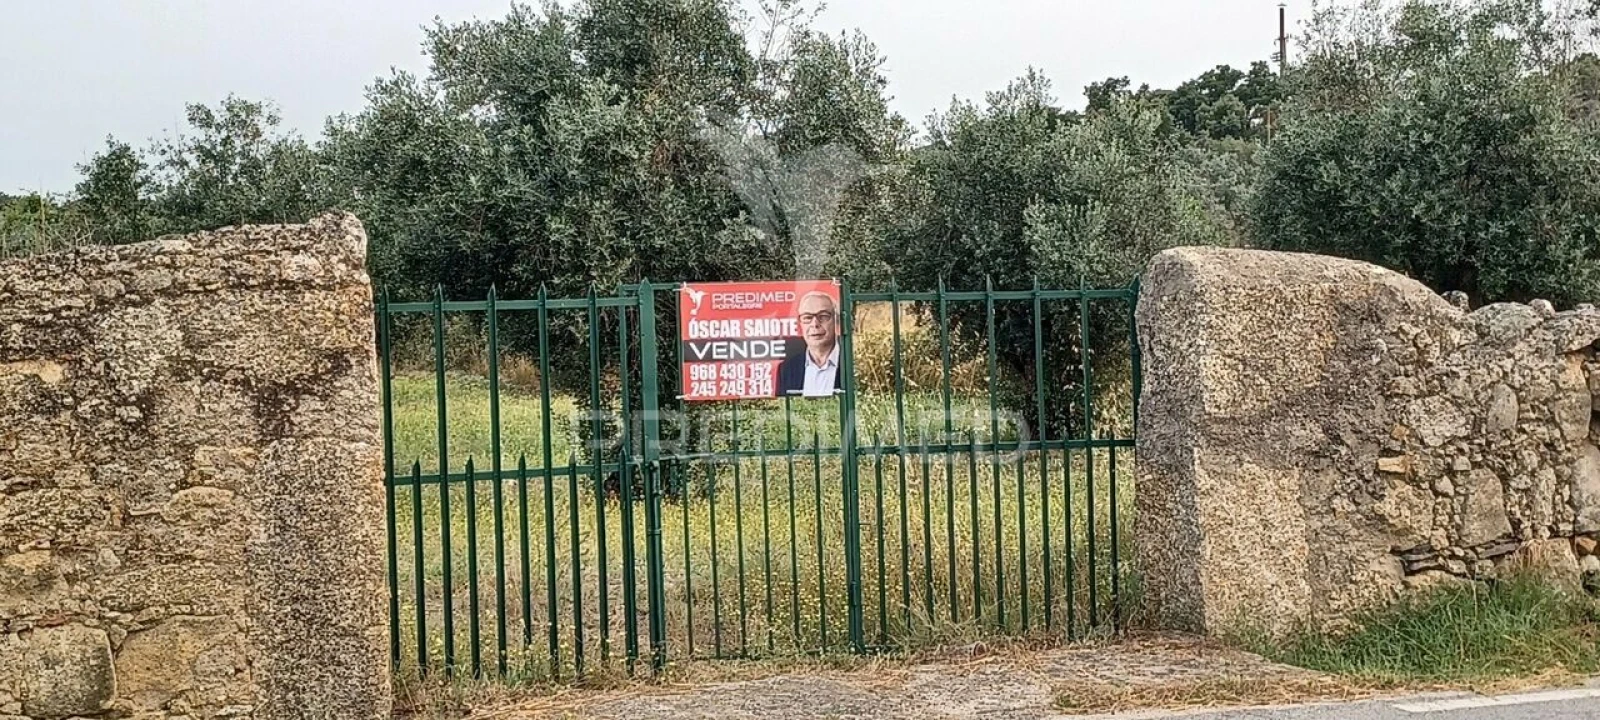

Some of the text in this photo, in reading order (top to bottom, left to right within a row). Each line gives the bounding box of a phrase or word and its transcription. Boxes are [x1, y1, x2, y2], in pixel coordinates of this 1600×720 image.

[712, 291, 796, 303] PREDIMED
[689, 318, 798, 338] ÓSCAR SAIOTE
[689, 340, 786, 360] VENDE
[690, 363, 772, 381] 968 430 152
[690, 379, 772, 397] 245 249 314
